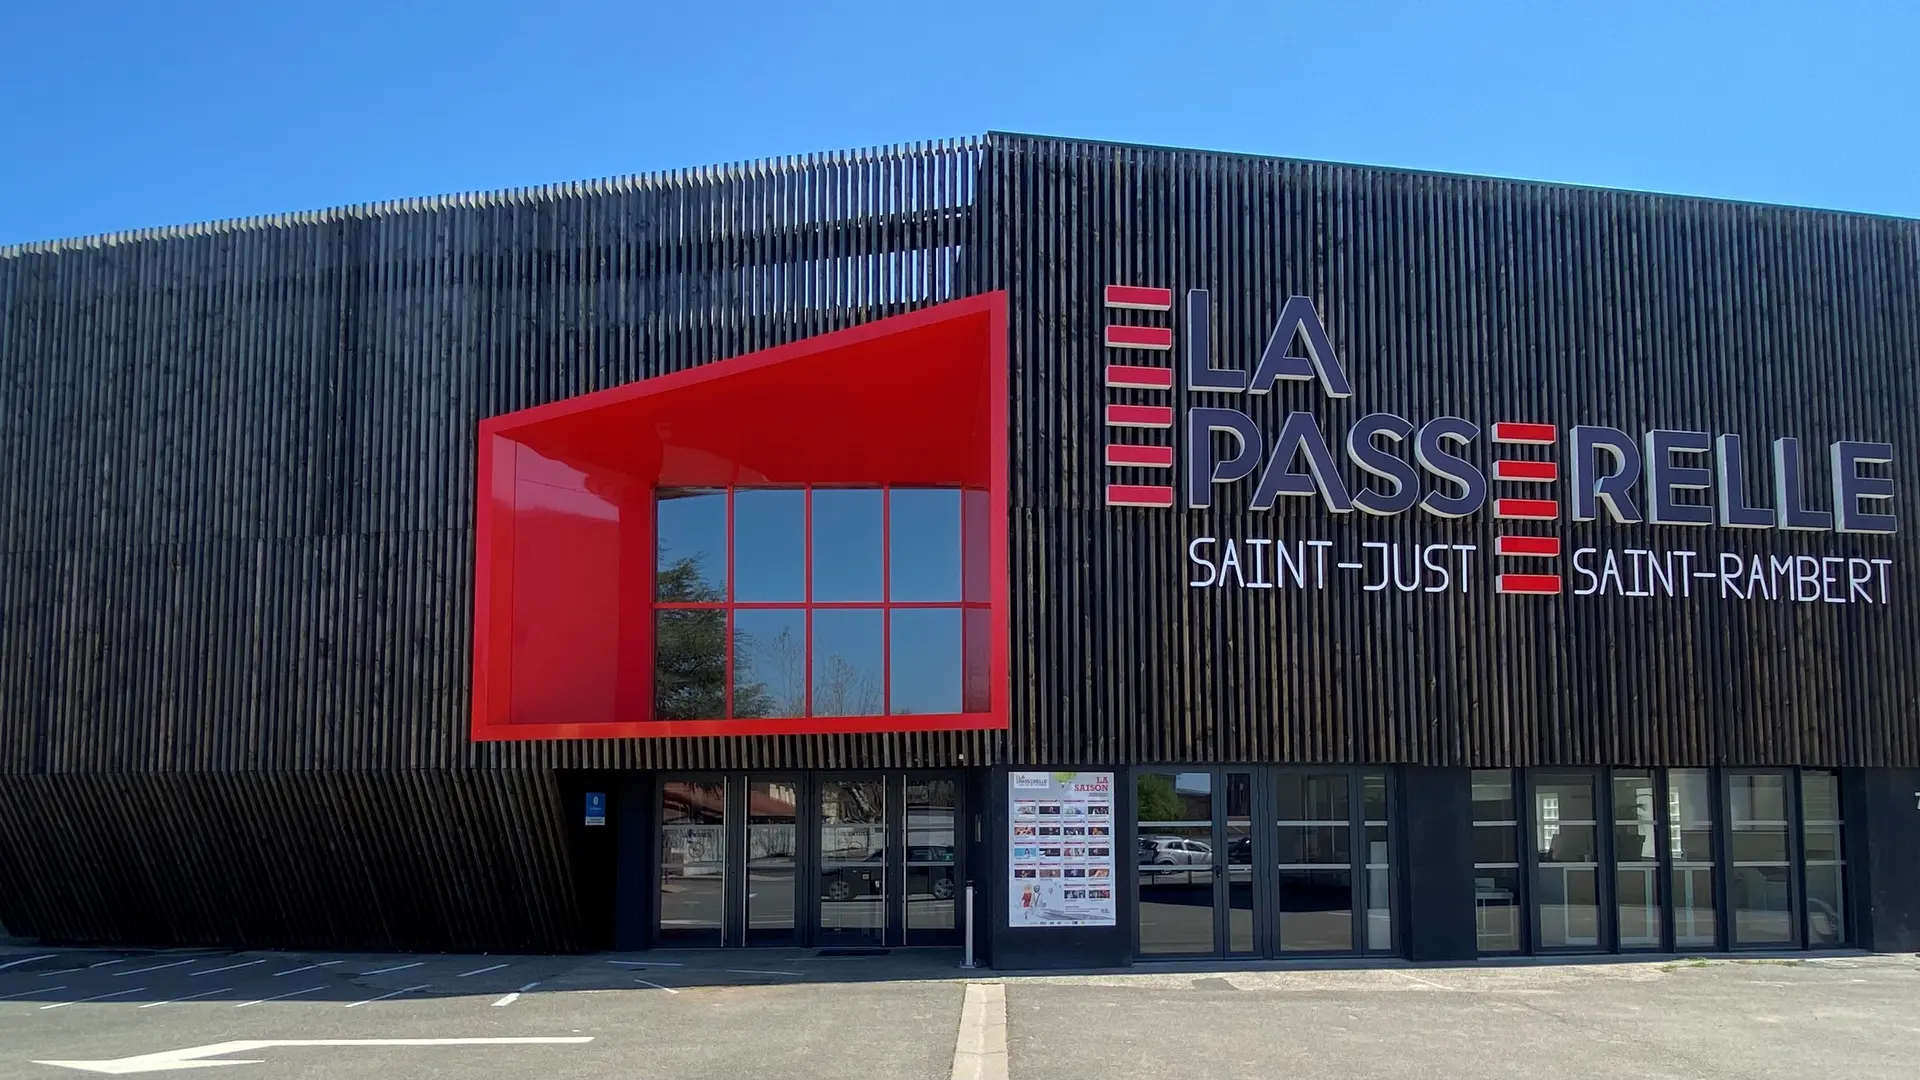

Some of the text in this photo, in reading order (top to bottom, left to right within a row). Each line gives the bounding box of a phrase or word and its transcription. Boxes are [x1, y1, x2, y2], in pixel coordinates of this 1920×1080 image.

[1187, 288, 1352, 399] LA
[1189, 537, 1892, 604] SAINT-JUST SAINT-RAMBERT
[1074, 784, 1109, 792] SAISON
[1096, 776, 1109, 784] LA
